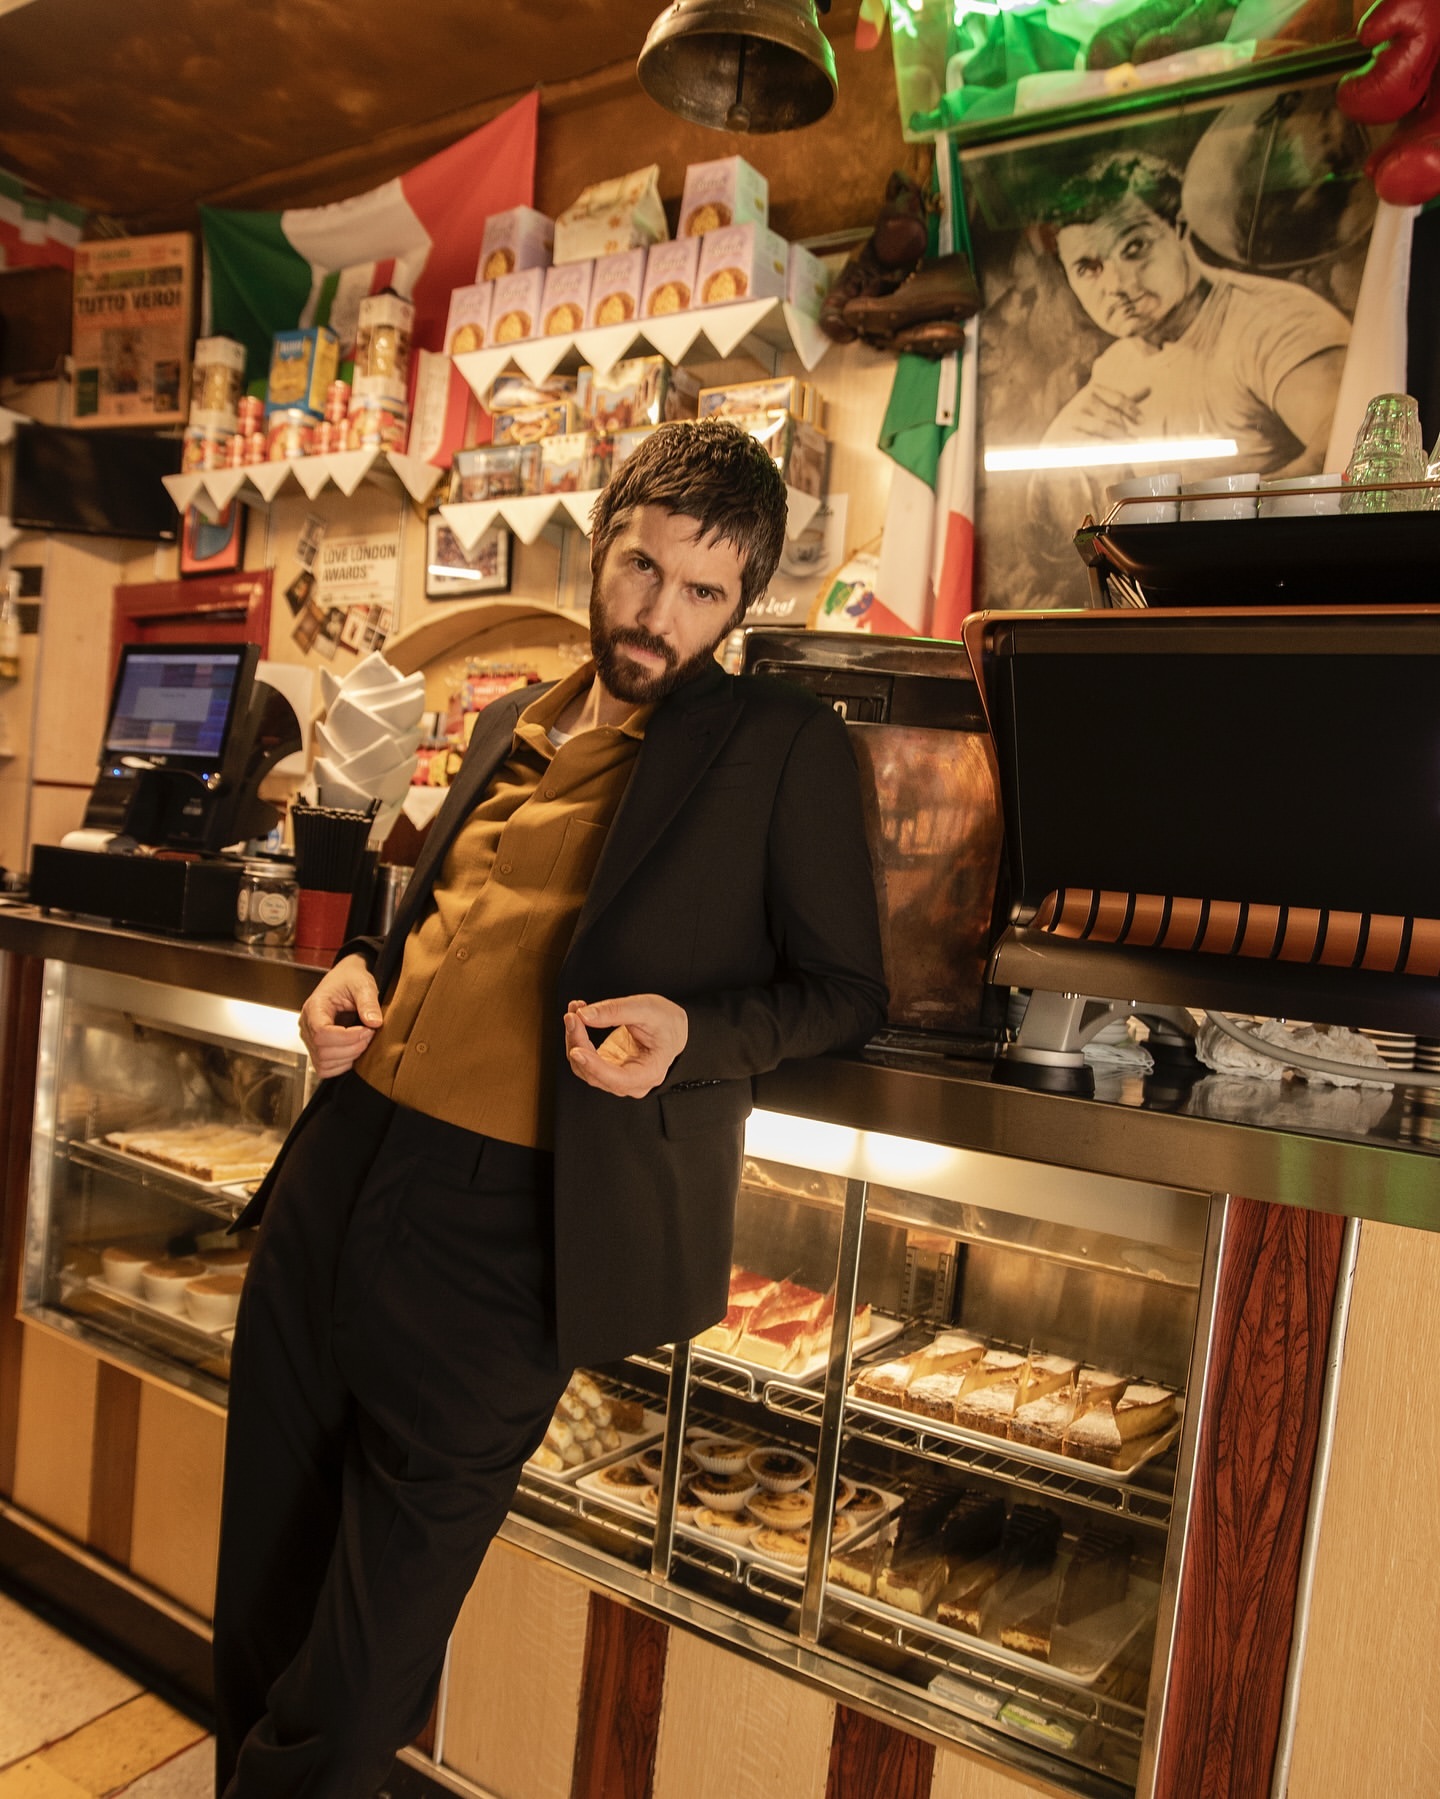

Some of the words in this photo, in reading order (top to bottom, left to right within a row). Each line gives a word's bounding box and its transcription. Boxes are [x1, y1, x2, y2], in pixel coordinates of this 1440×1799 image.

[323, 548, 347, 564] LOVE
[351, 544, 396, 562] LONDON
[323, 565, 367, 581] AWARDS
